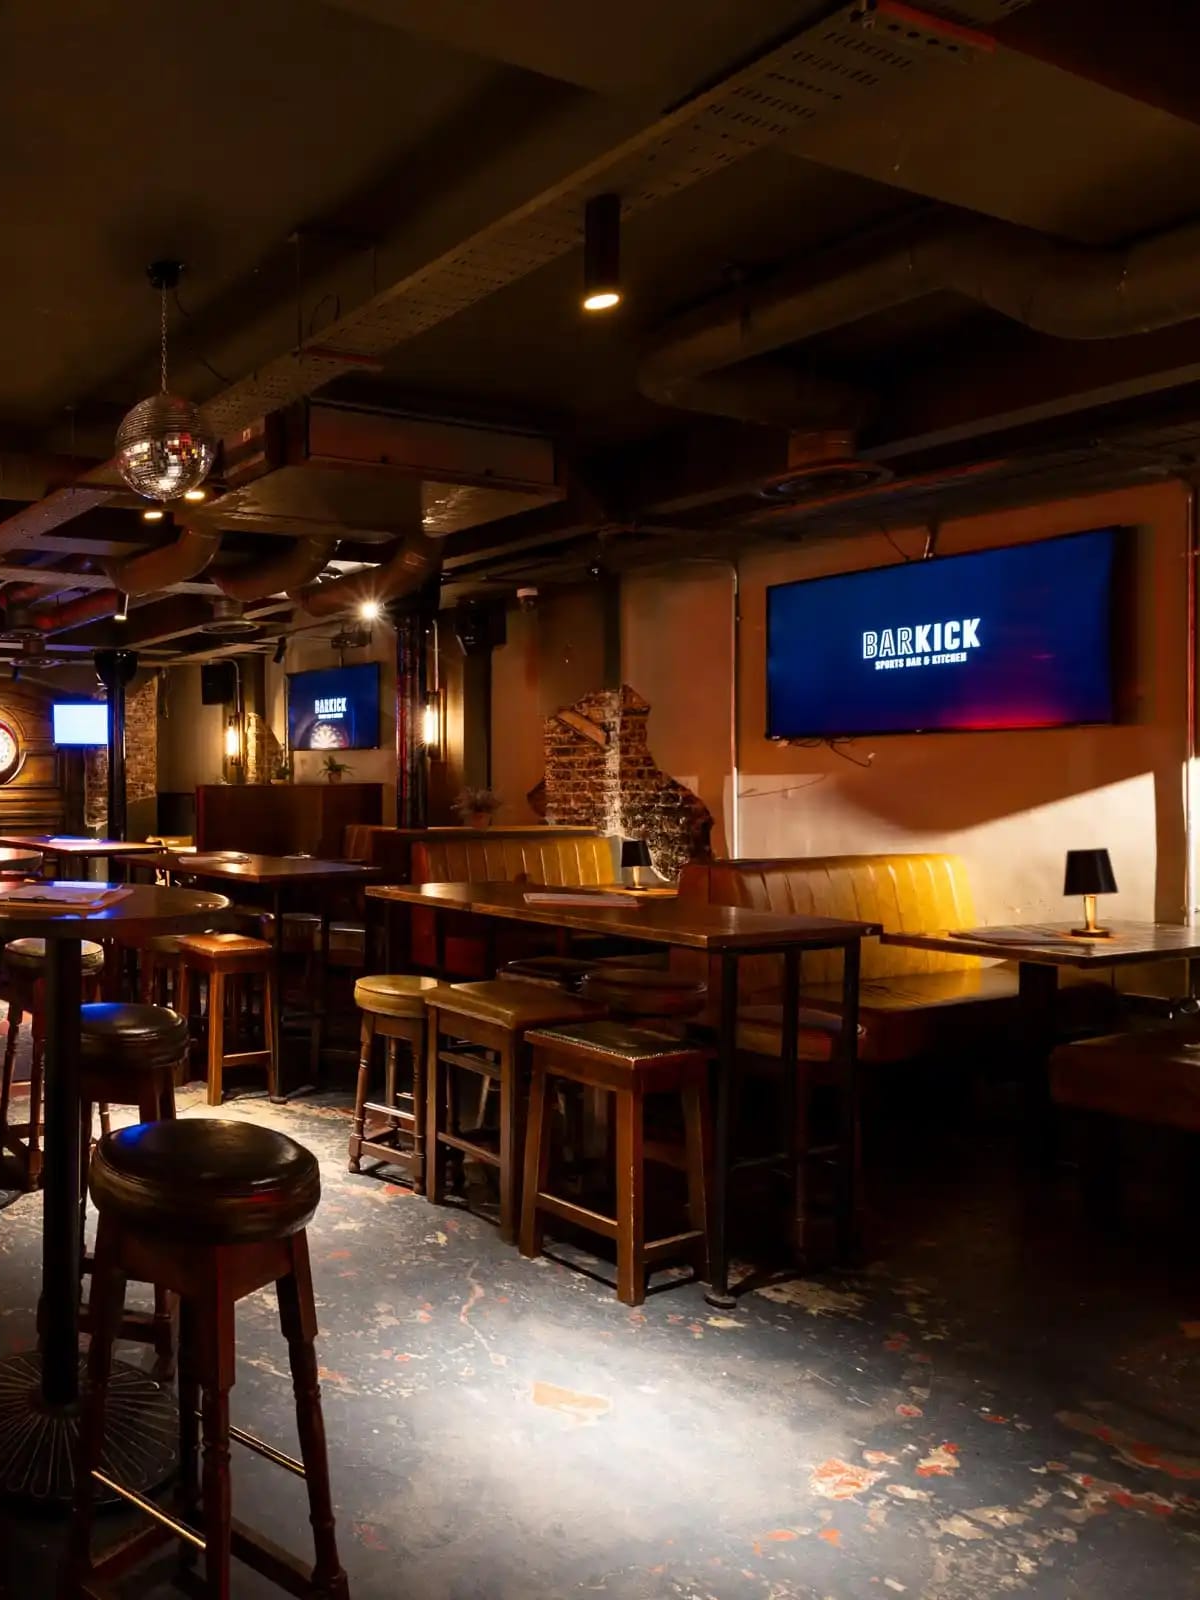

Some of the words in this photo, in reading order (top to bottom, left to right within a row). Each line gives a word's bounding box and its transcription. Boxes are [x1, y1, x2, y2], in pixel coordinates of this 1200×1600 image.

[862, 618, 981, 659] BARKICK
[874, 658, 904, 670] SPORTS
[905, 656, 922, 667] BAR
[931, 652, 967, 665] KITCHEN
